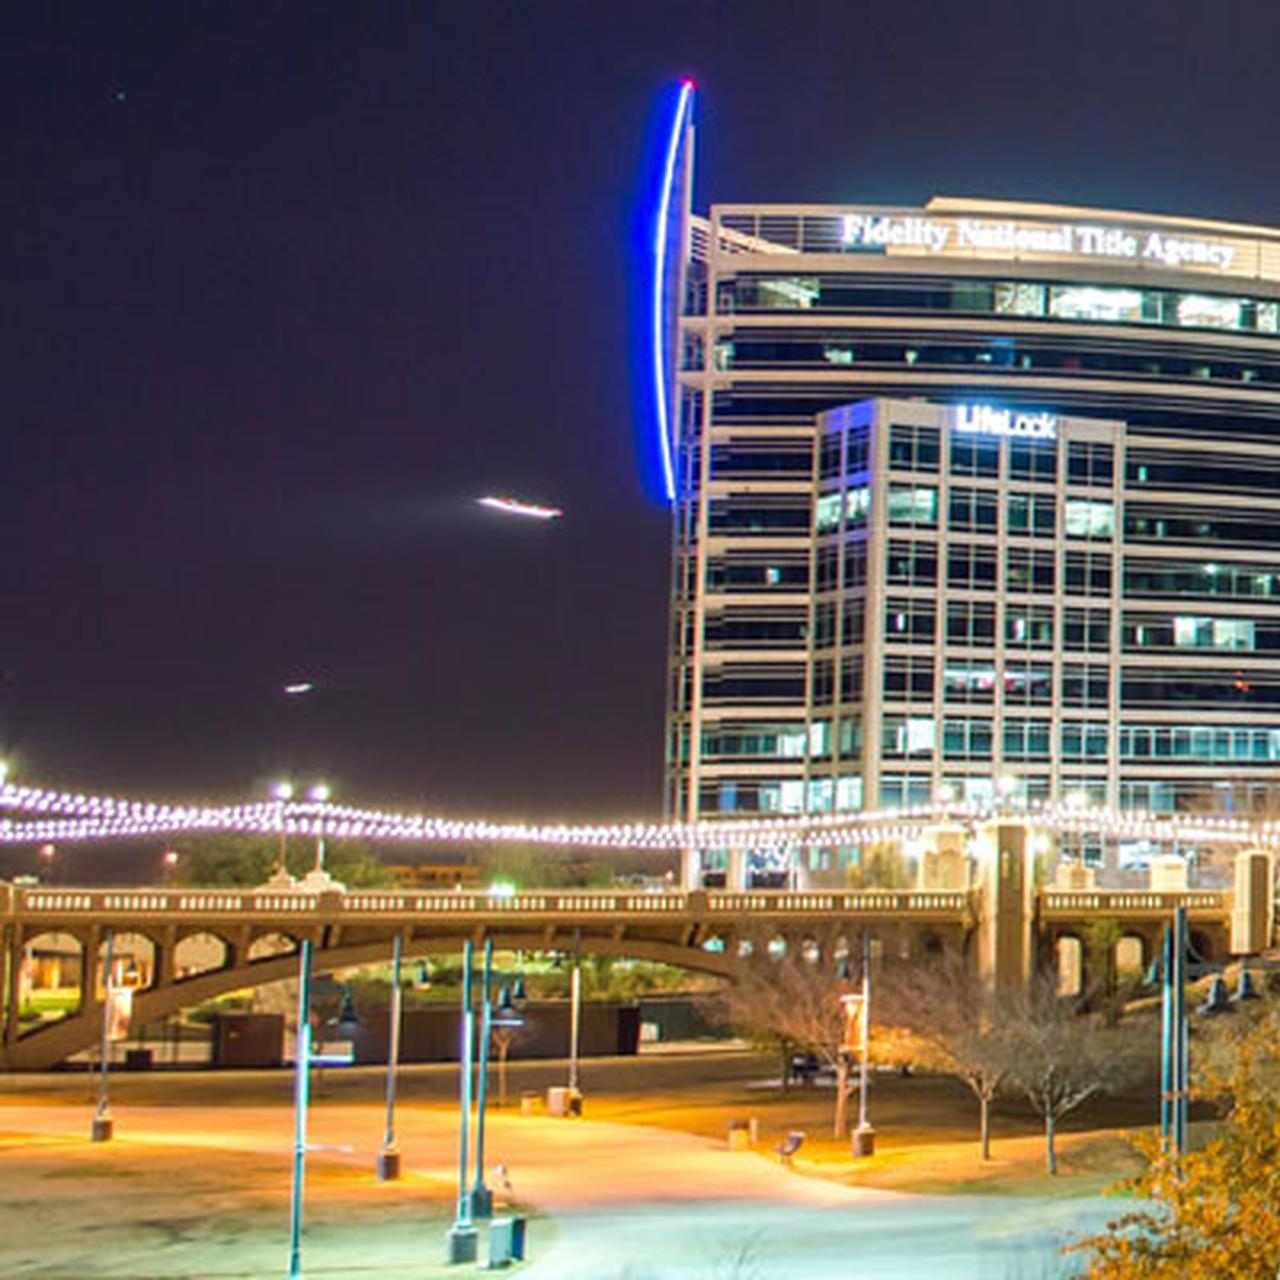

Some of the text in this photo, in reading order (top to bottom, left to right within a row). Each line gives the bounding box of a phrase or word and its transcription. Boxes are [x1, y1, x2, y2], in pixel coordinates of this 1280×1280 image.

[842, 214, 1236, 270] Fidelity National Title Agency
